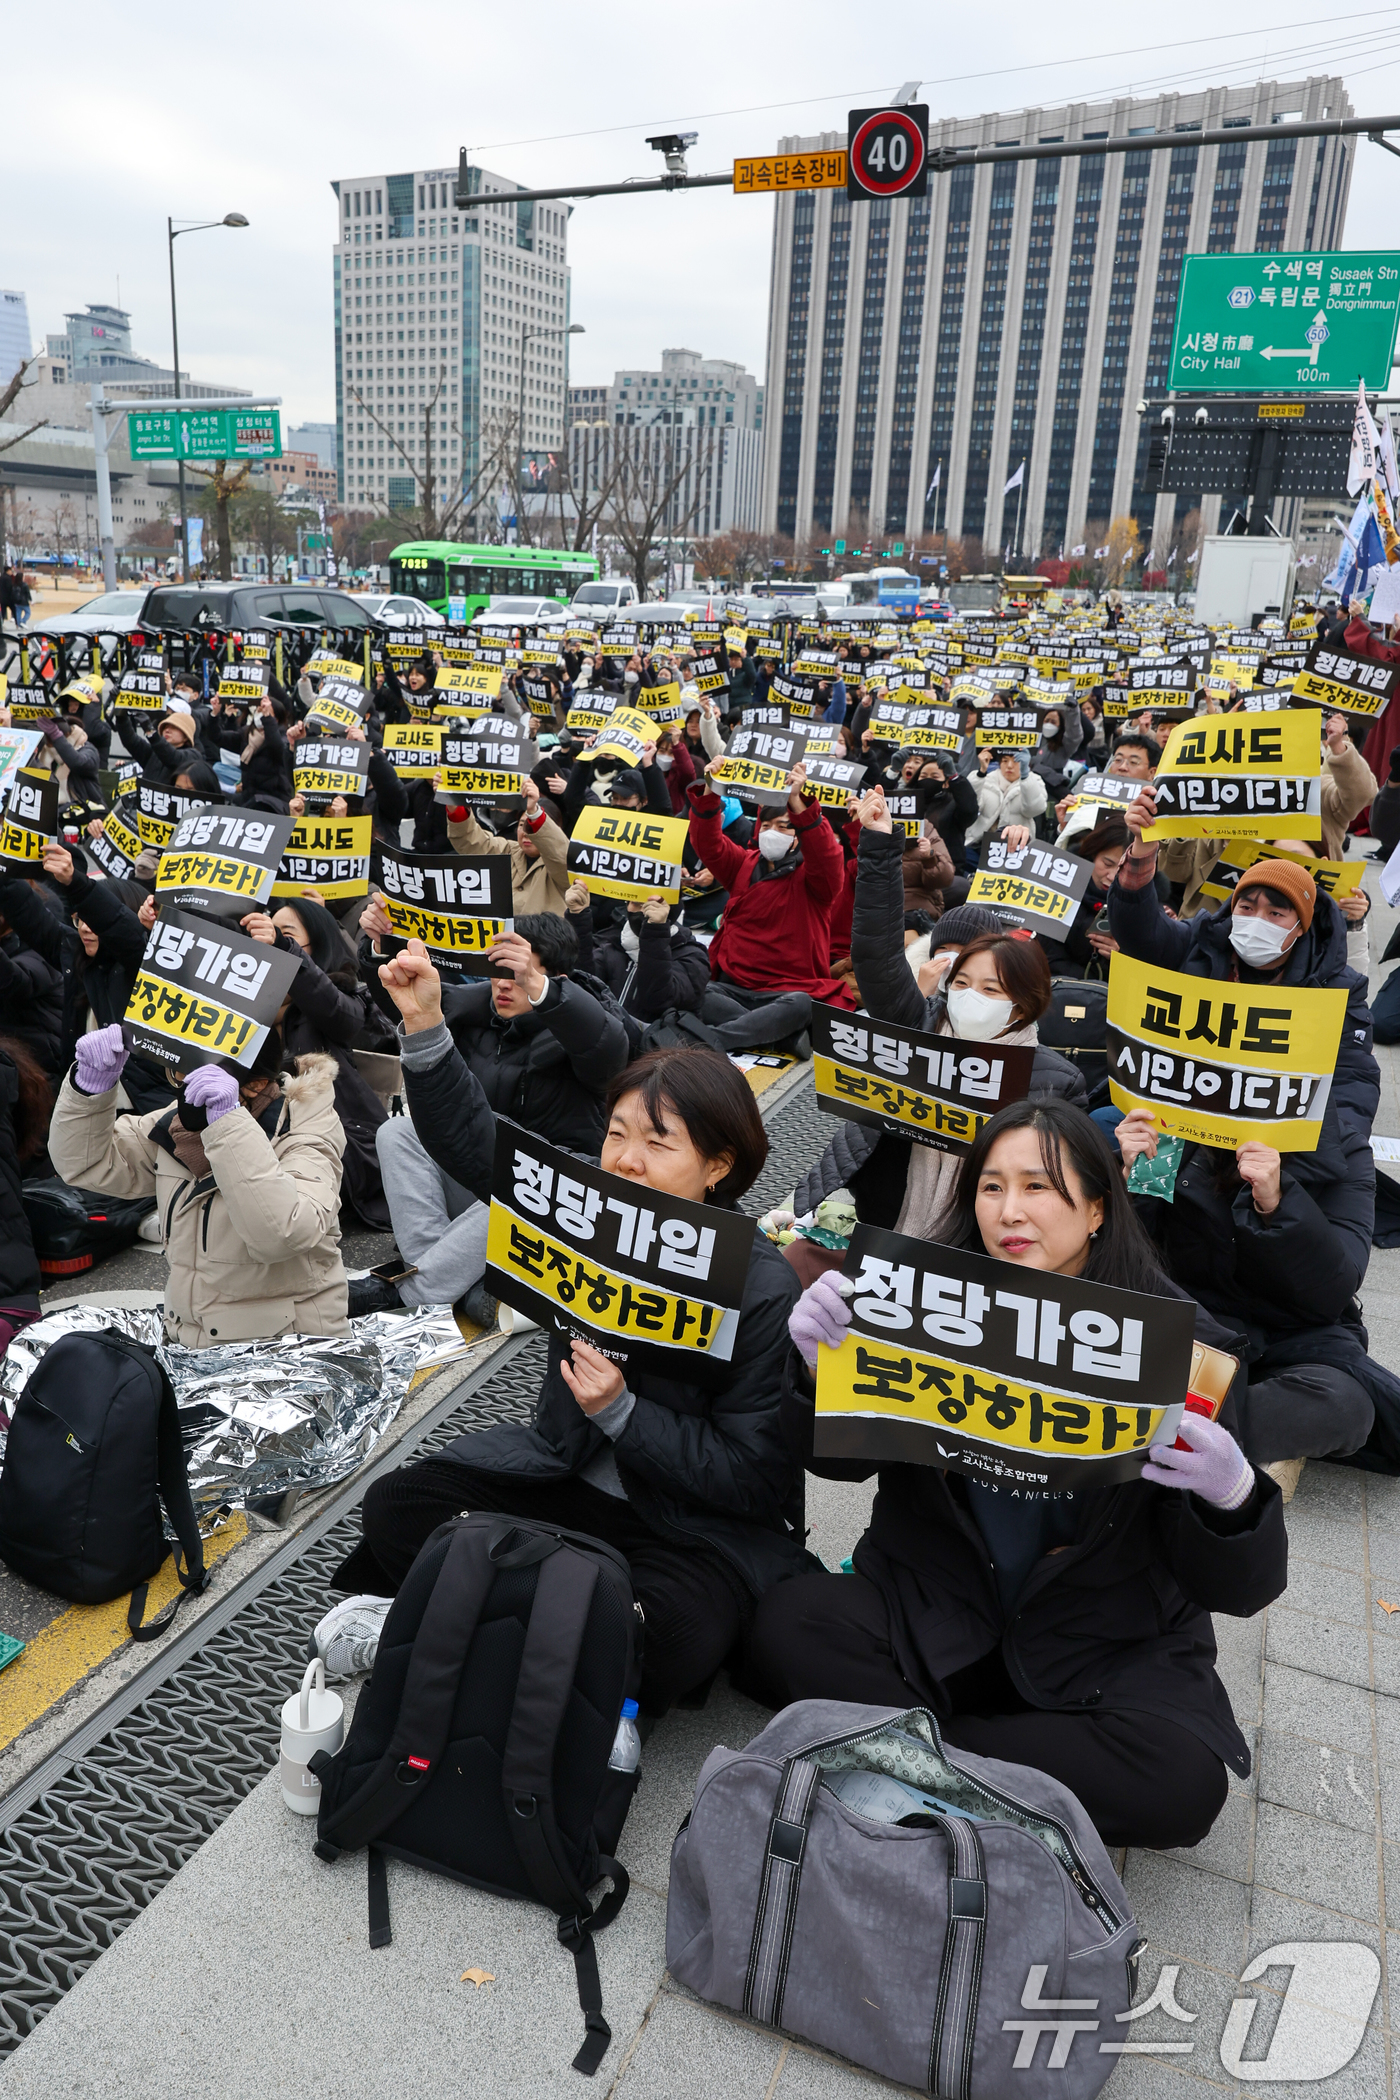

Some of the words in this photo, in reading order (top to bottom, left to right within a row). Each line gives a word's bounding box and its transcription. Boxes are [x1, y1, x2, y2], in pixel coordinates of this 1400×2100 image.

[868, 134, 907, 173] 40
[739, 157, 841, 187] 과속단속장비
[1262, 260, 1323, 281] 수색역
[1330, 267, 1374, 280] Susaek
[1378, 266, 1398, 280] Stn
[1235, 291, 1249, 304] 21
[1258, 287, 1321, 307] 독립문
[1326, 298, 1396, 312] Dongnimmun
[1181, 332, 1219, 352] 시청
[1310, 329, 1324, 340] 50
[1180, 356, 1209, 372] City
[1214, 357, 1241, 369] Hall
[1296, 368, 1330, 382] 100m
[401, 558, 428, 570] 7025
[389, 632, 423, 644] 정당가입
[445, 638, 477, 649] 정당가입
[525, 639, 559, 651] 정당가입
[602, 634, 635, 644] 정당가입
[1170, 638, 1210, 653] 정당가입
[1232, 635, 1268, 647] 정당가입
[223, 665, 263, 681] 정당가입
[326, 663, 353, 675] 교사도
[1132, 670, 1188, 687] 정당가입
[1314, 651, 1393, 690] 정당가입
[121, 675, 160, 691] 정당가입
[220, 683, 263, 696] 보장하라!
[448, 674, 489, 689] 교사도
[773, 676, 814, 701] 정당가입
[11, 688, 46, 704] 정당가입
[119, 693, 162, 709] 보장하라!
[438, 690, 493, 708] 시민이다!
[574, 694, 617, 712] 정당가입
[1132, 692, 1188, 706] 보장하라!
[1304, 678, 1383, 714] 보장하라!
[878, 704, 909, 721] 정당
[907, 709, 960, 730] 정당가입
[981, 712, 1037, 728] 정당가입
[395, 731, 434, 746] 교사도
[789, 720, 834, 738] 당가입
[982, 732, 1038, 746] 보장하라!
[903, 730, 958, 750] 보장하라!
[1175, 727, 1284, 765] 교사도
[296, 743, 360, 767] 정당가입
[445, 740, 520, 765] 정당가입
[295, 771, 359, 793] 보장하라!
[447, 770, 521, 792] 보장하라!
[719, 761, 787, 790] 보장하라!
[1083, 777, 1142, 800] 정당가
[1154, 778, 1305, 811] 시민이다!
[174, 815, 276, 854] 정당가입
[287, 828, 353, 850] 교사도
[595, 817, 664, 850] 교사도
[576, 849, 671, 886] 시민이다!
[987, 841, 1079, 888] 정당가입
[159, 856, 264, 896] 보장하라!
[381, 855, 491, 905] 정당가입
[977, 877, 1069, 918] 보장하라!
[1140, 985, 1291, 1055] 교사도
[828, 1019, 1005, 1101] 정당가입
[1117, 1047, 1311, 1116] 시민이다!
[833, 1067, 988, 1136] 보장하라
[512, 1148, 717, 1281] 정당가입
[508, 1223, 714, 1347] 보장하라!
[853, 1254, 1144, 1382] 정당가입
[852, 1347, 1152, 1451] 보장하라!
[962, 1454, 1049, 1484] 교사노동조합연맹
